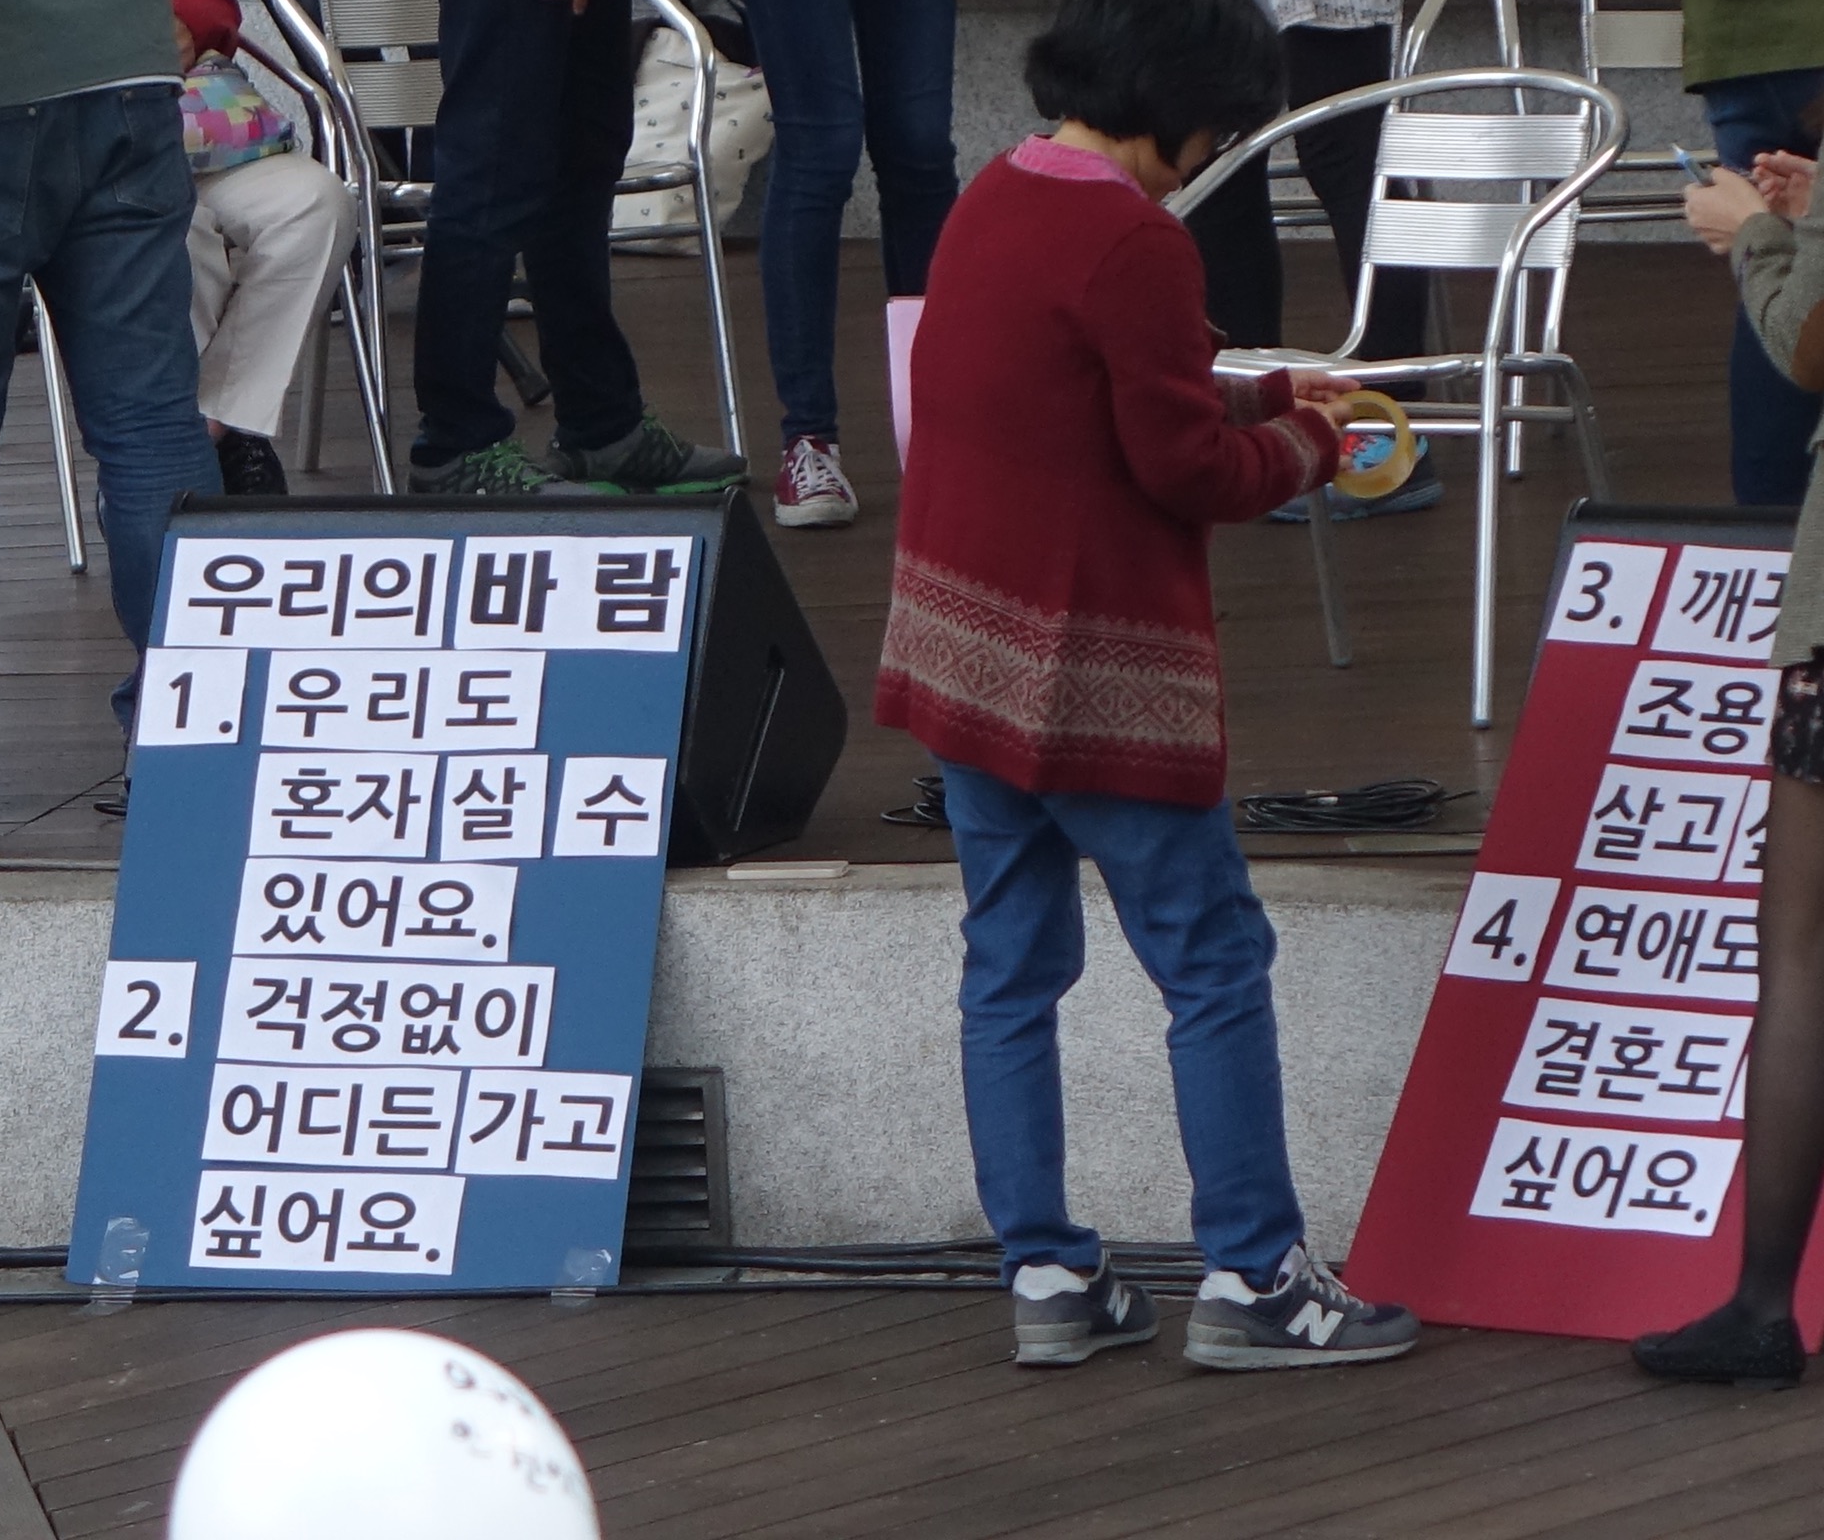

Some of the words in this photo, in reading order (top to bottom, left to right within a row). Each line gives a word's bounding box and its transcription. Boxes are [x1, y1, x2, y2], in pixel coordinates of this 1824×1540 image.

[189, 554, 436, 636] 우리의
[1566, 562, 1621, 628] 3.
[171, 673, 232, 733] 1.
[277, 668, 516, 738] 우리도
[272, 769, 420, 839] 혼자
[454, 768, 525, 840] 살
[577, 775, 648, 845] 수
[1594, 785, 1724, 861] 살고
[262, 874, 496, 948] 있어요.
[1472, 899, 1526, 966] 4.
[119, 981, 182, 1045] 2.
[247, 978, 538, 1055] 걱정없이
[1535, 1019, 1727, 1101] 결혼도
[223, 1082, 440, 1155] 어디든
[471, 1089, 615, 1161] 가고
[1502, 1137, 1706, 1222] 싶어요.
[202, 1186, 439, 1261] 싶어요.
